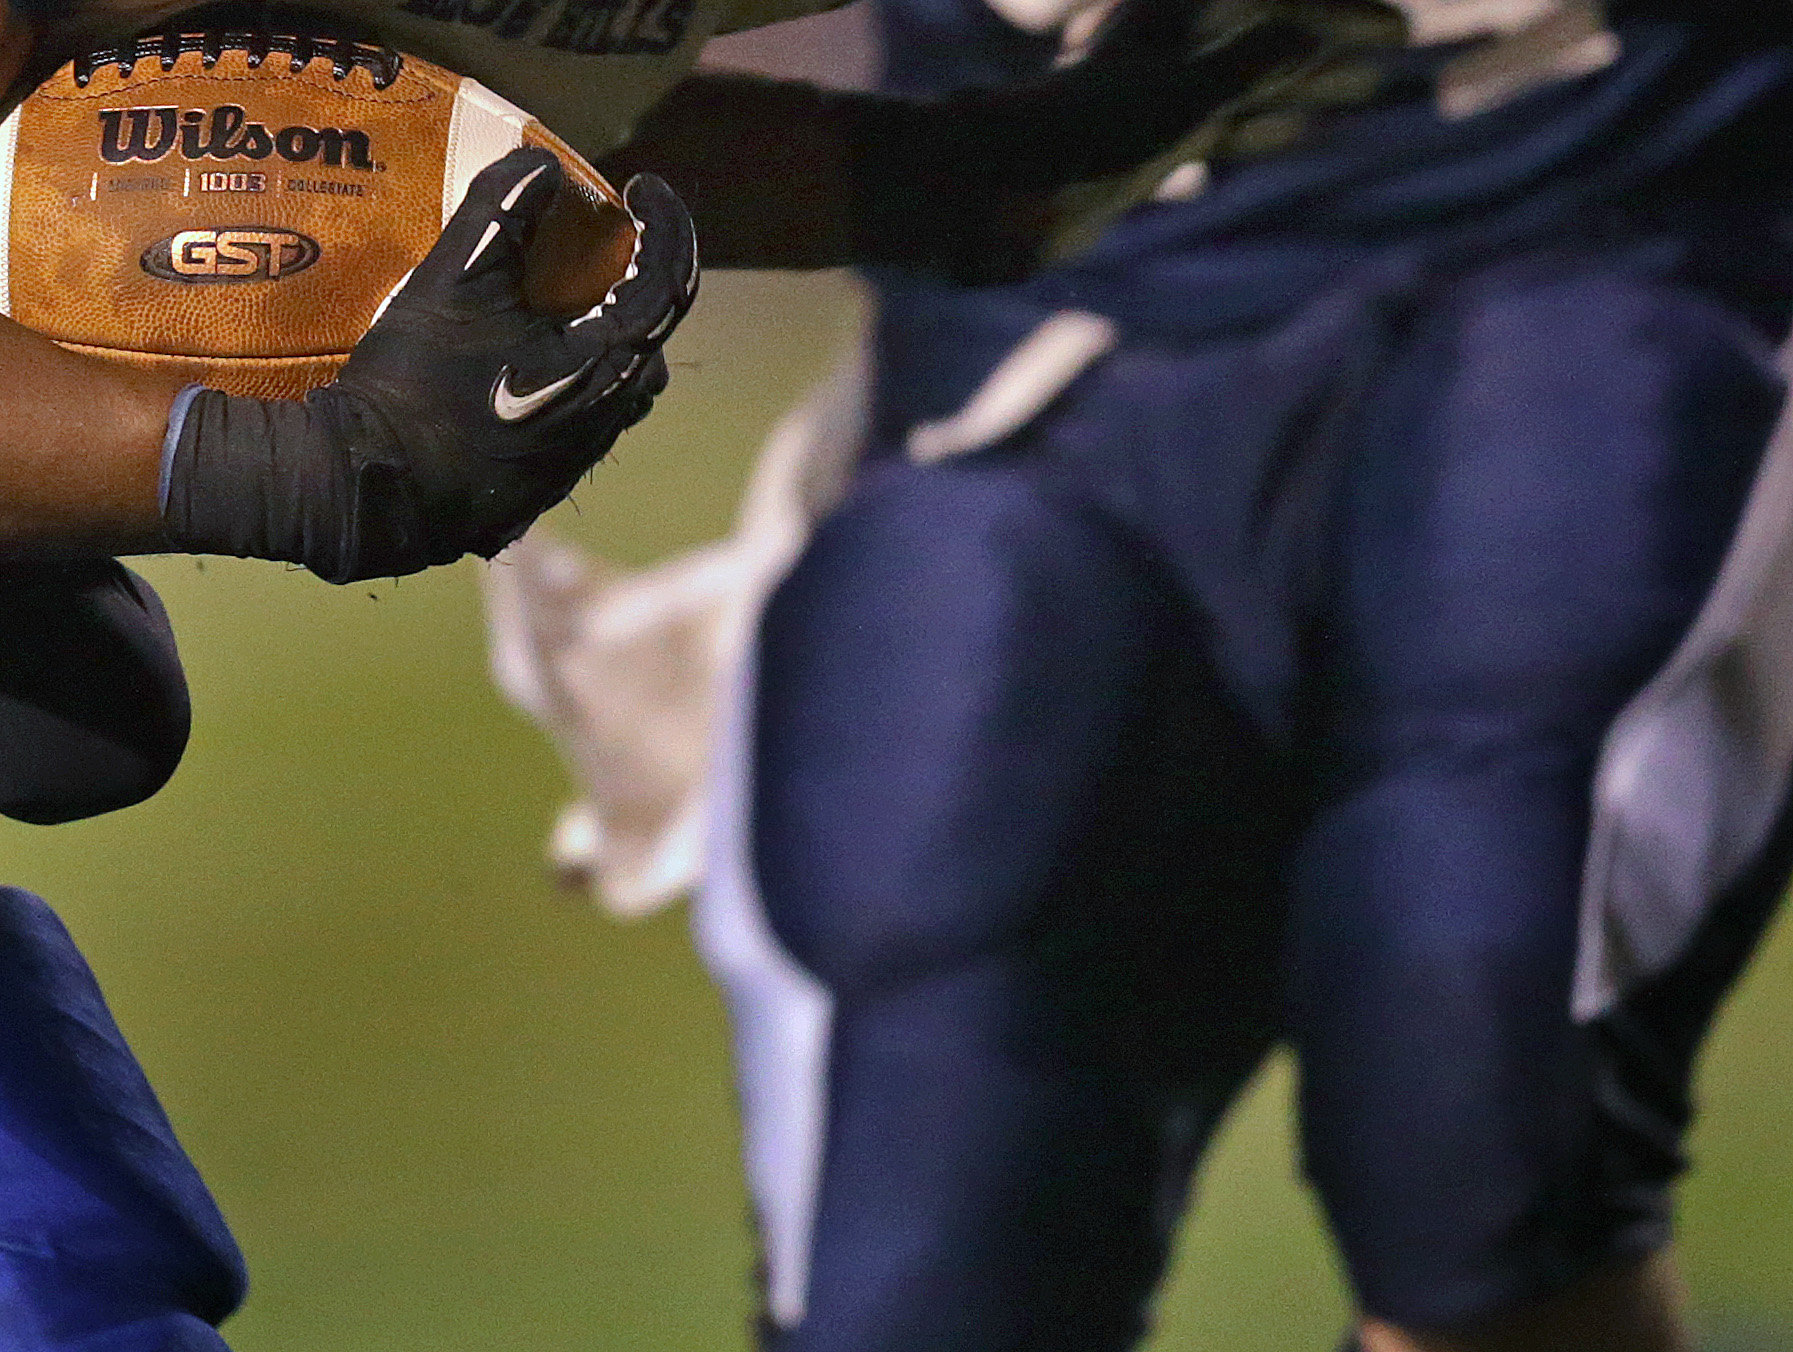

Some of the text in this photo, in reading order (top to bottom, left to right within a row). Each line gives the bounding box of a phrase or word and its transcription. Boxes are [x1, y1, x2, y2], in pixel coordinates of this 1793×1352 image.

[98, 103, 376, 172] Wilson
[199, 172, 364, 197] 1003 COLLEGIATE
[171, 229, 299, 279] GST
